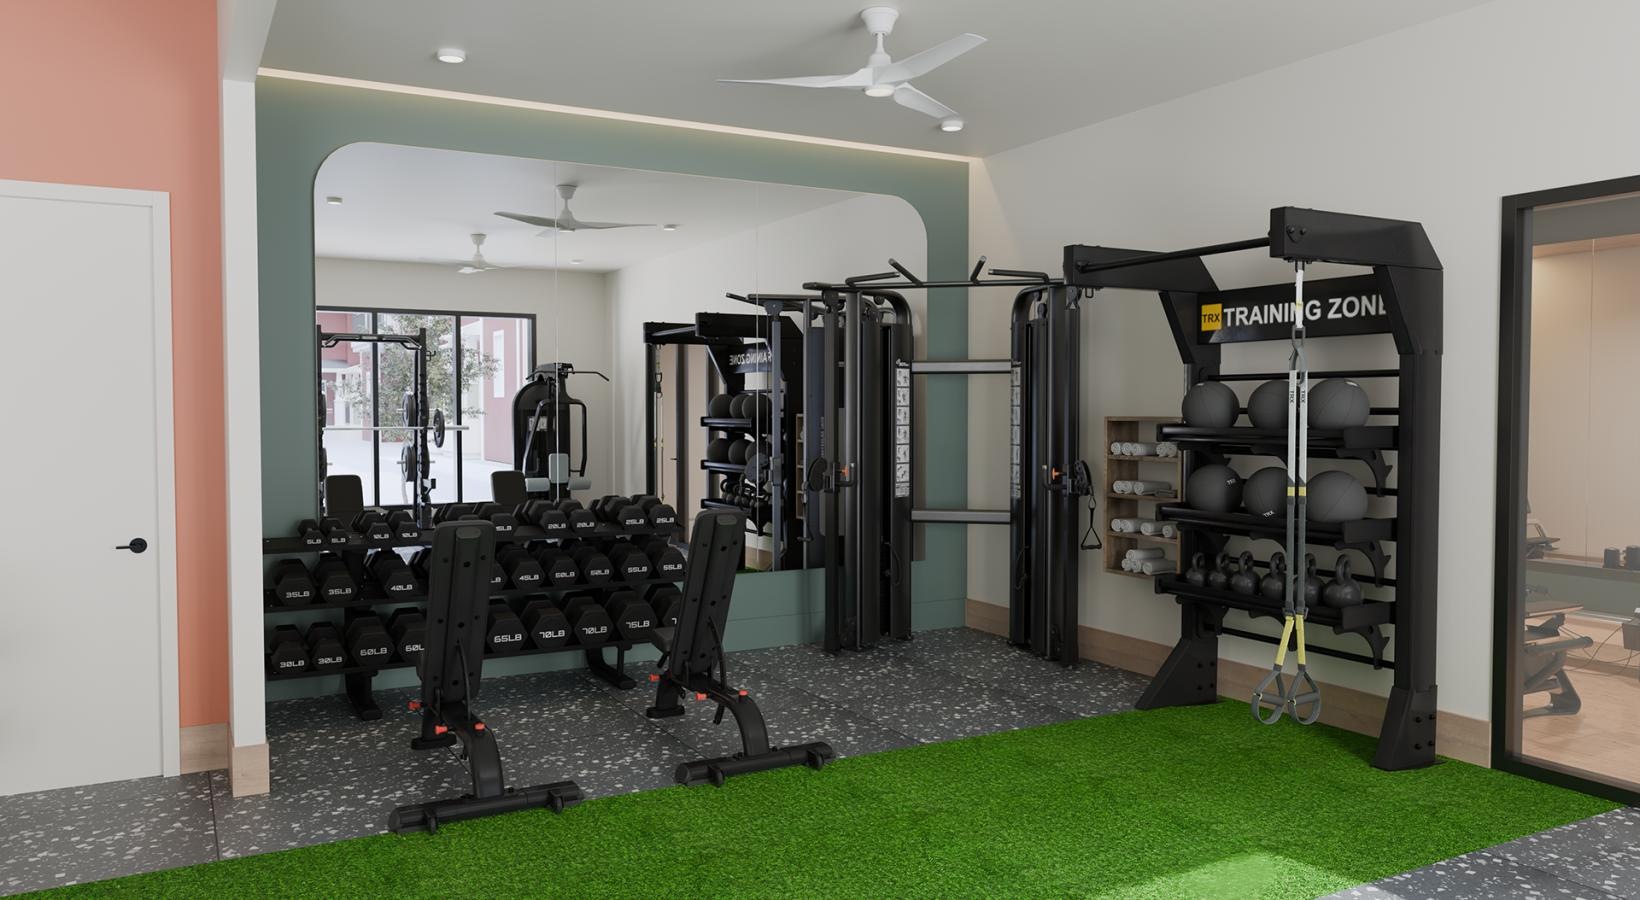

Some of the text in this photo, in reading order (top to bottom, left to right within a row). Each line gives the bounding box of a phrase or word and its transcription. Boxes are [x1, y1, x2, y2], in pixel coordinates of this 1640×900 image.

[1203, 313, 1220, 324] TRX
[626, 518, 644, 526] 25LB
[656, 516, 674, 524] 25LB
[628, 566, 647, 574] 55LB
[663, 563, 682, 571] 55LB
[391, 583, 412, 591] 40LB
[626, 620, 649, 628] 75LB
[539, 630, 565, 638] 70LB
[582, 626, 607, 634] 70LB
[494, 634, 522, 643] 65LB
[360, 648, 387, 656] 60LB
[406, 644, 424, 652] 60L
[280, 660, 304, 668] 30LB
